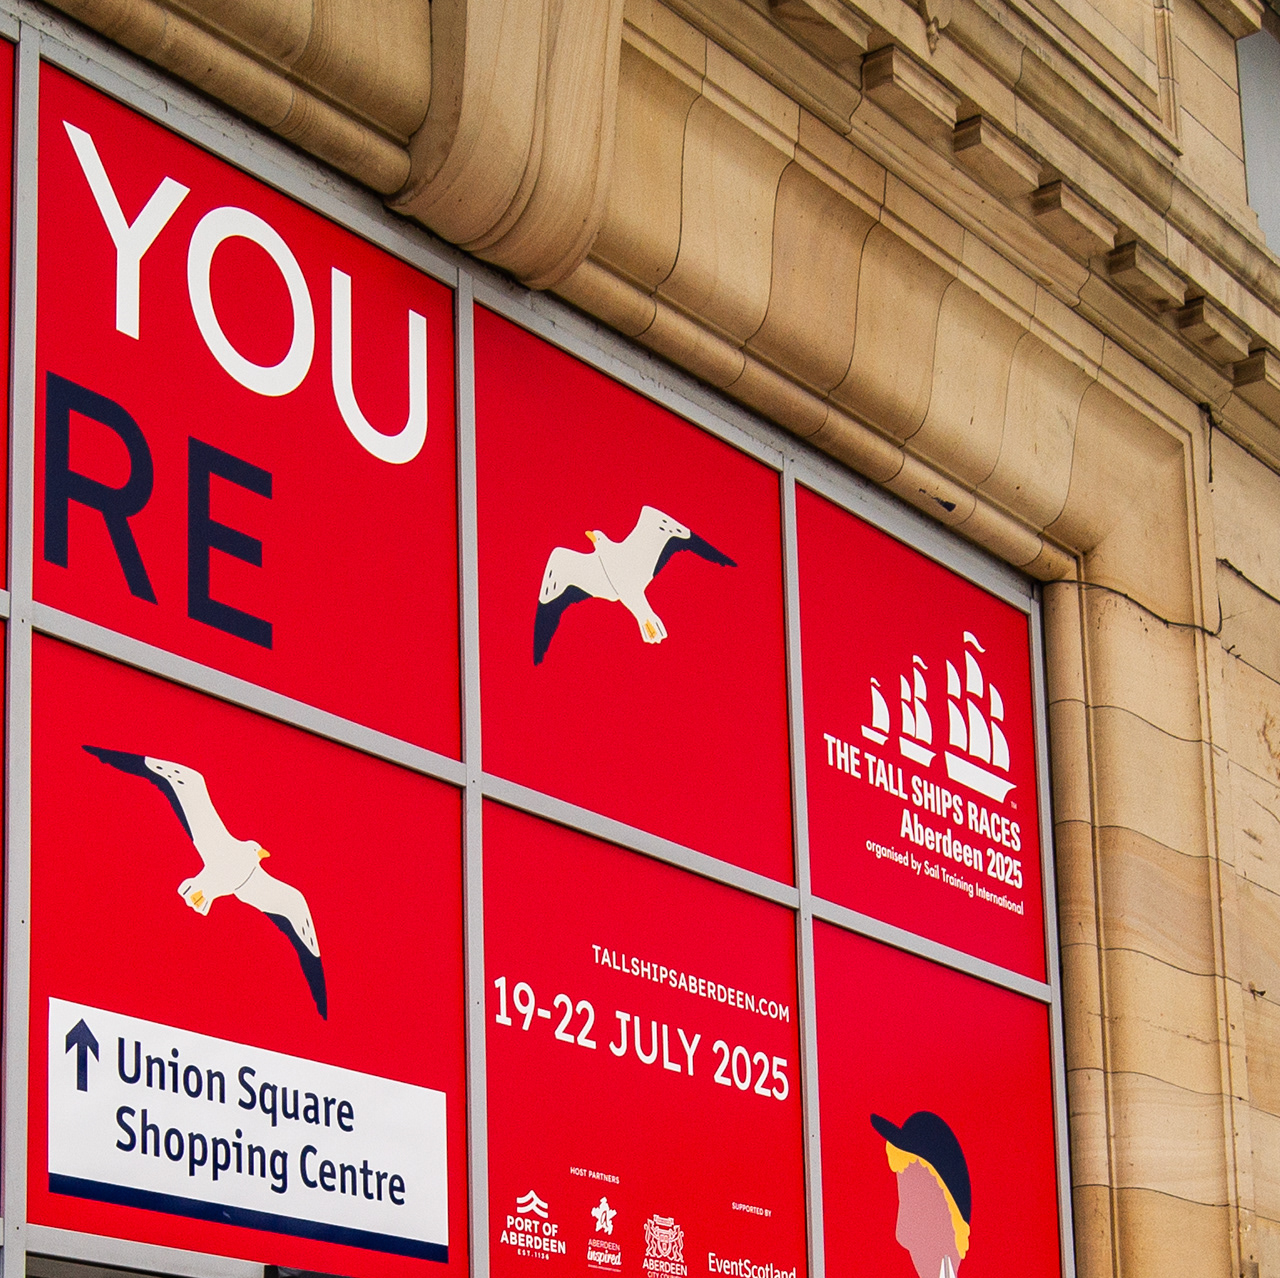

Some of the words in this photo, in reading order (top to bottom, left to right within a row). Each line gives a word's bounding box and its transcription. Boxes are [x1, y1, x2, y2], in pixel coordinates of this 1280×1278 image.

[62, 120, 427, 465] YOU
[823, 733, 861, 779] THE
[864, 752, 908, 801] TALL
[911, 775, 963, 825] SHIPS
[968, 801, 1021, 852] RACES
[866, 840, 909, 867] organised
[911, 854, 922, 875] by
[924, 859, 940, 880] Sail
[941, 867, 974, 898] Training
[976, 881, 1024, 915] International
[900, 809, 983, 872] Aberdeen
[987, 848, 1022, 889] 2025
[592, 944, 789, 1023] TALLSHIPSABERDEEN.COM
[494, 976, 596, 1050] 19-22
[609, 1009, 701, 1076] JULY
[712, 1040, 789, 1101] 2025
[117, 1036, 225, 1103] Union
[238, 1065, 354, 1132] Square
[115, 1105, 289, 1194] Shopping
[299, 1144, 406, 1206] Centre
[570, 1166, 587, 1177] HOST
[588, 1170, 620, 1184] PARTNERS
[500, 1230, 566, 1254] ABERDEEN
[507, 1215, 540, 1234] PORT
[542, 1222, 559, 1237] OF
[588, 1239, 620, 1251] ABERDEEN
[732, 1202, 764, 1216] SUPPORTED
[764, 1208, 772, 1218] BY
[642, 1258, 688, 1276] ABERDEEN
